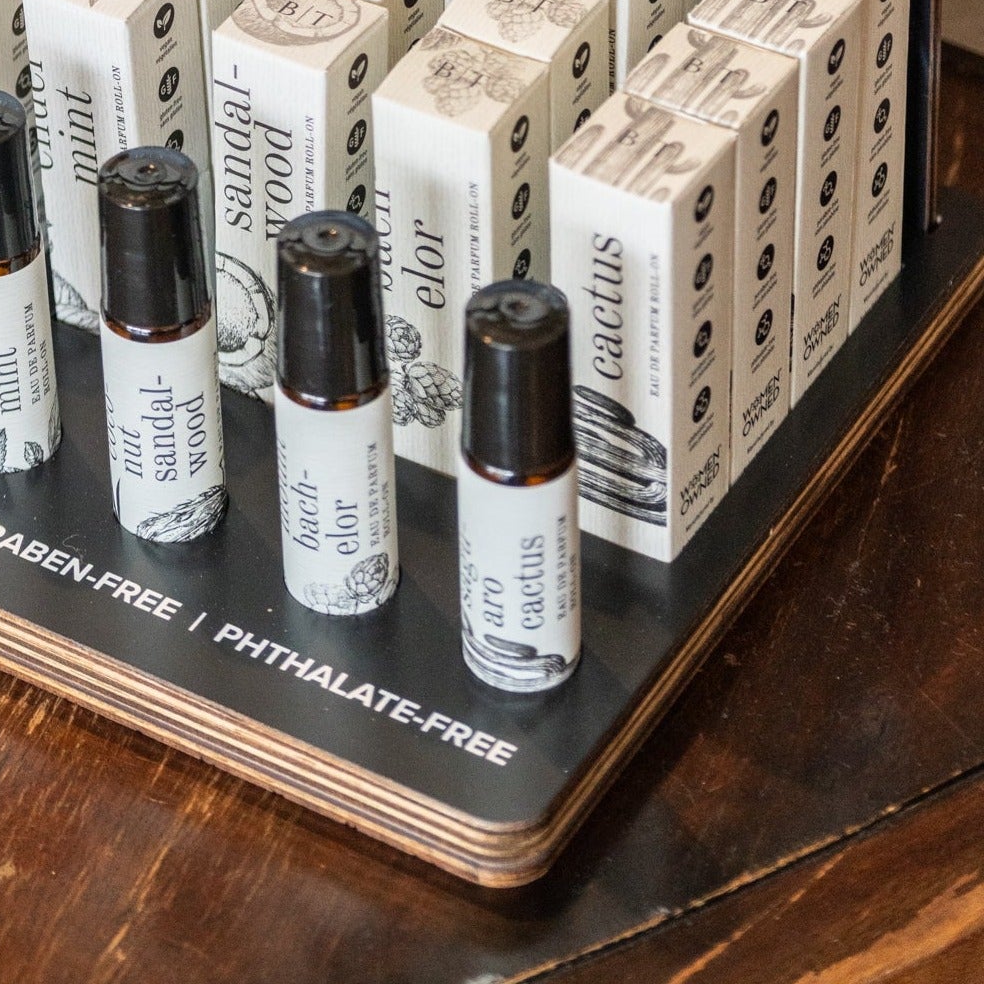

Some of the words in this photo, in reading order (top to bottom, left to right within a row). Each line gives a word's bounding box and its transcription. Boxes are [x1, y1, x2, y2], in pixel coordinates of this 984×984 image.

[112, 65, 124, 113] ROLL-ON
[56, 86, 99, 187] mint
[214, 64, 253, 233] sandal-
[304, 115, 315, 165] ROLL-ON
[253, 120, 293, 241] wood
[401, 218, 446, 310] elor
[859, 239, 894, 288] OWNED
[24, 302, 36, 356] PARFUM
[583, 232, 624, 381] cactus
[802, 311, 840, 362] OWNED
[28, 357, 38, 376] DE
[30, 379, 41, 405] EAU
[139, 376, 178, 482] sandal-
[176, 391, 208, 478] wood
[742, 386, 781, 438] OWNED
[117, 425, 143, 479] nut
[290, 469, 320, 552] bach-
[680, 462, 721, 516] OWNED
[325, 499, 360, 555] elor
[483, 577, 504, 628] aro
[512, 535, 545, 630] cactus
[213, 622, 518, 768] PHTHALATE-FREE
